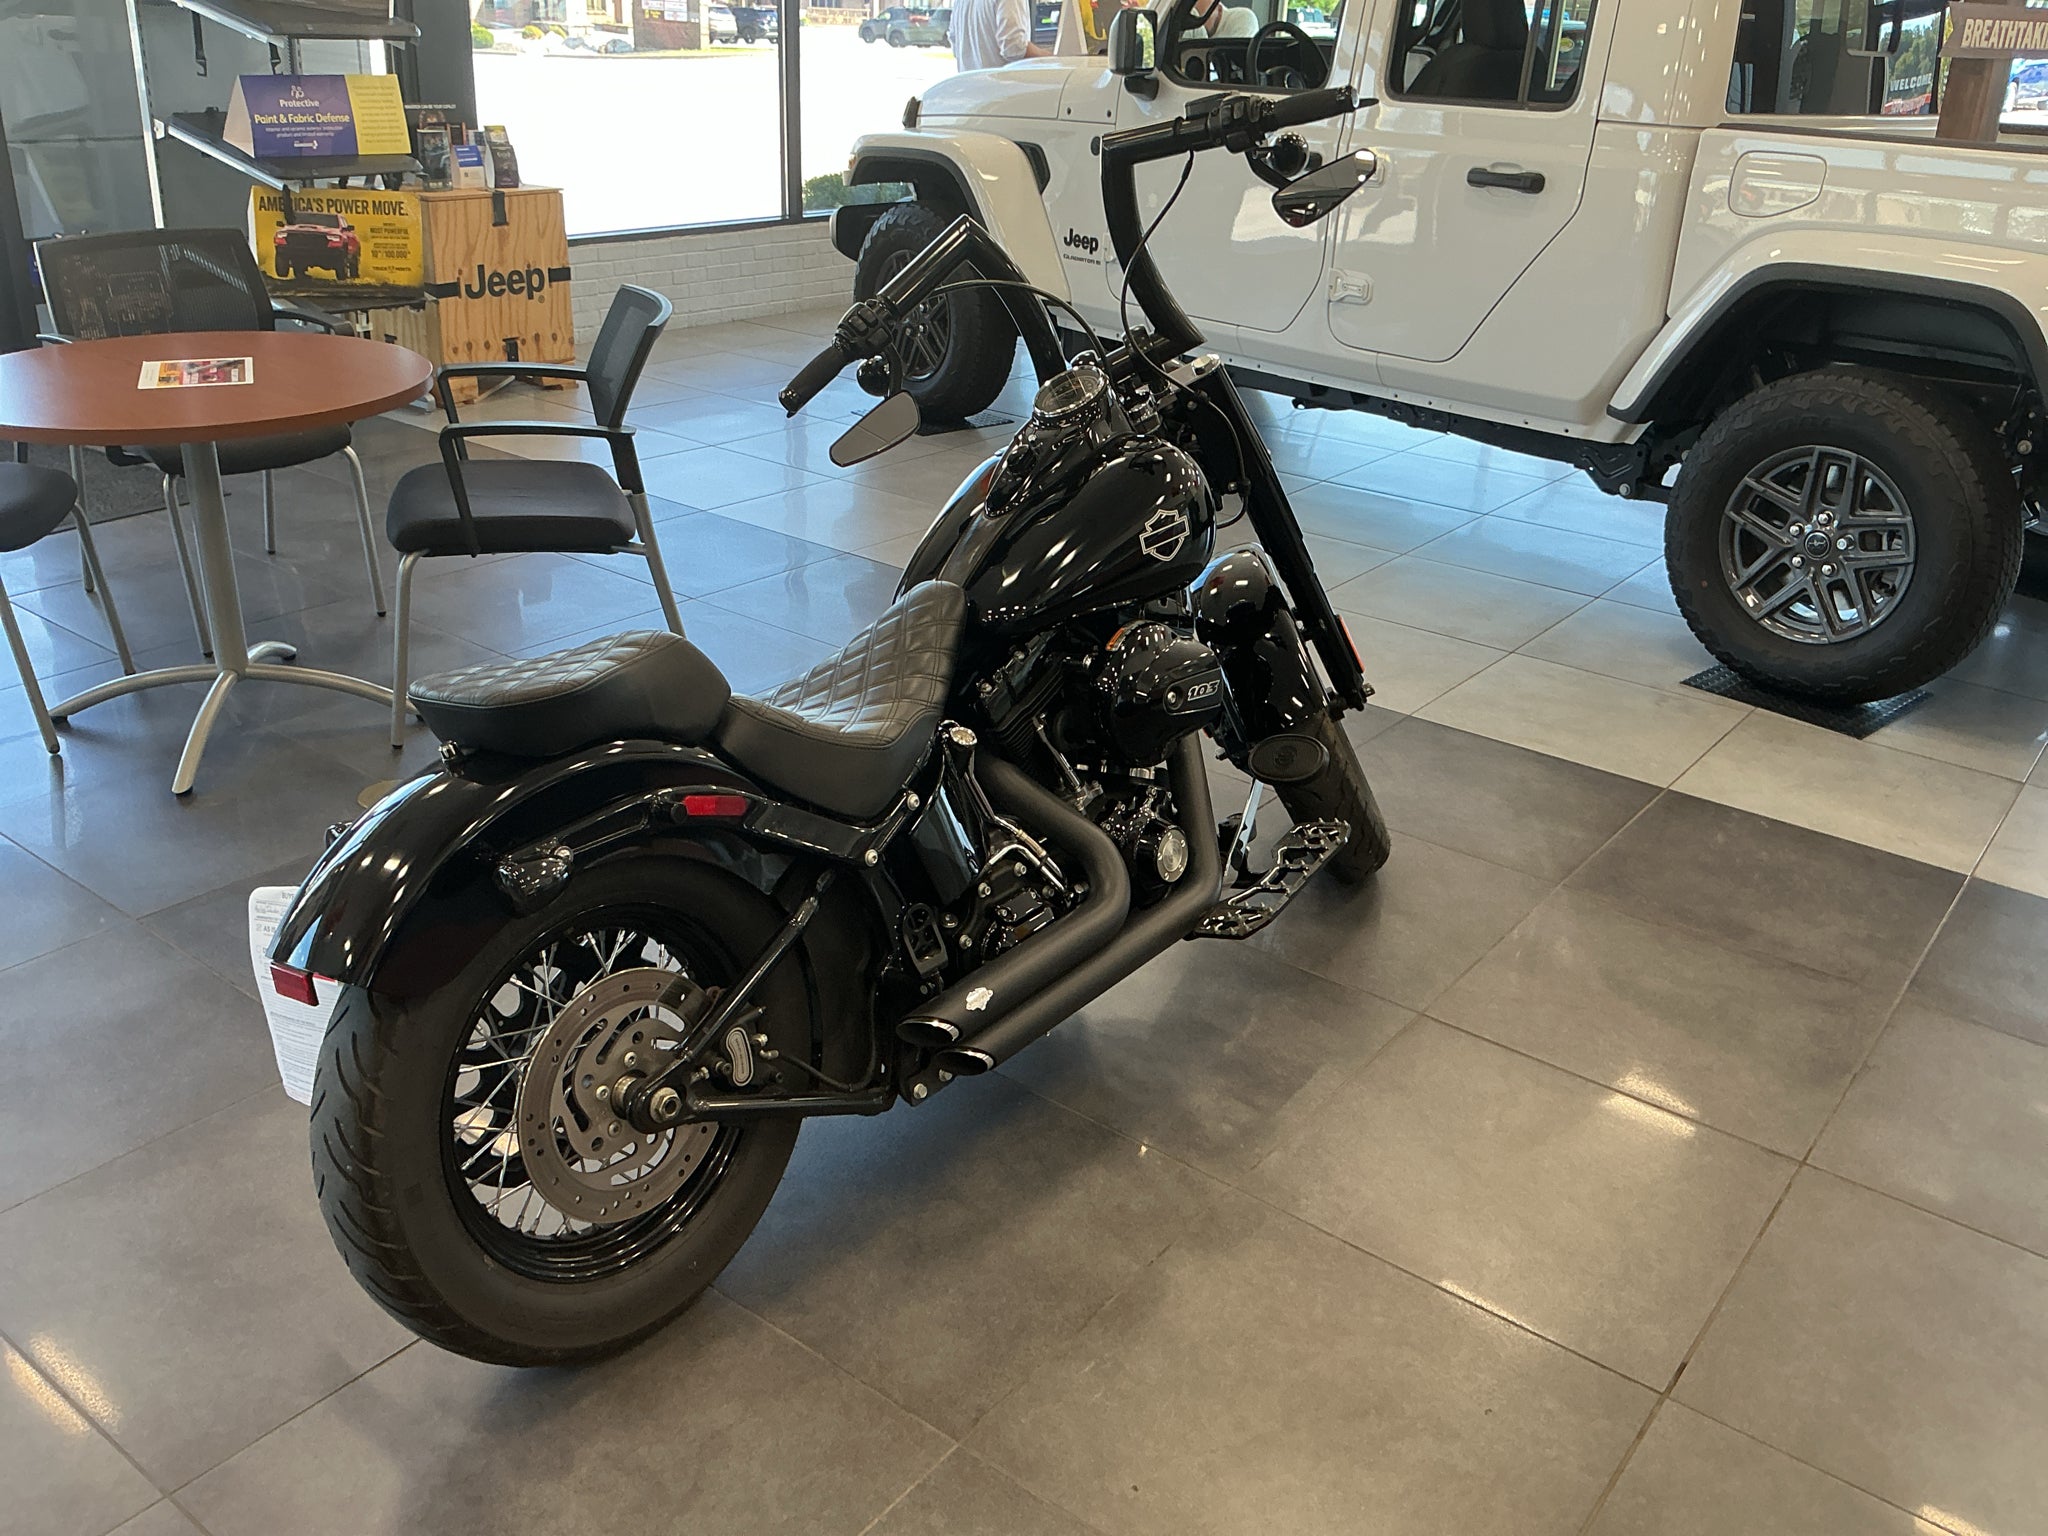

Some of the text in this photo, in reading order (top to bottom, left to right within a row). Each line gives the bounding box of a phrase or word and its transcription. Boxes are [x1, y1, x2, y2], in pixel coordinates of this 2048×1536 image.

[1960, 18, 2048, 50] BREATHTAKI
[1890, 73, 1932, 92] WELCOME
[279, 99, 320, 108] Protective
[254, 114, 277, 124] Paint
[279, 114, 287, 124] &
[288, 113, 314, 123] Fabric
[315, 112, 350, 123] Defense
[258, 196, 409, 217] AMEICA'S POWER MOVE.
[1063, 227, 1099, 255] Jeep
[464, 264, 546, 301] Jeep
[1188, 679, 1221, 702] 103
